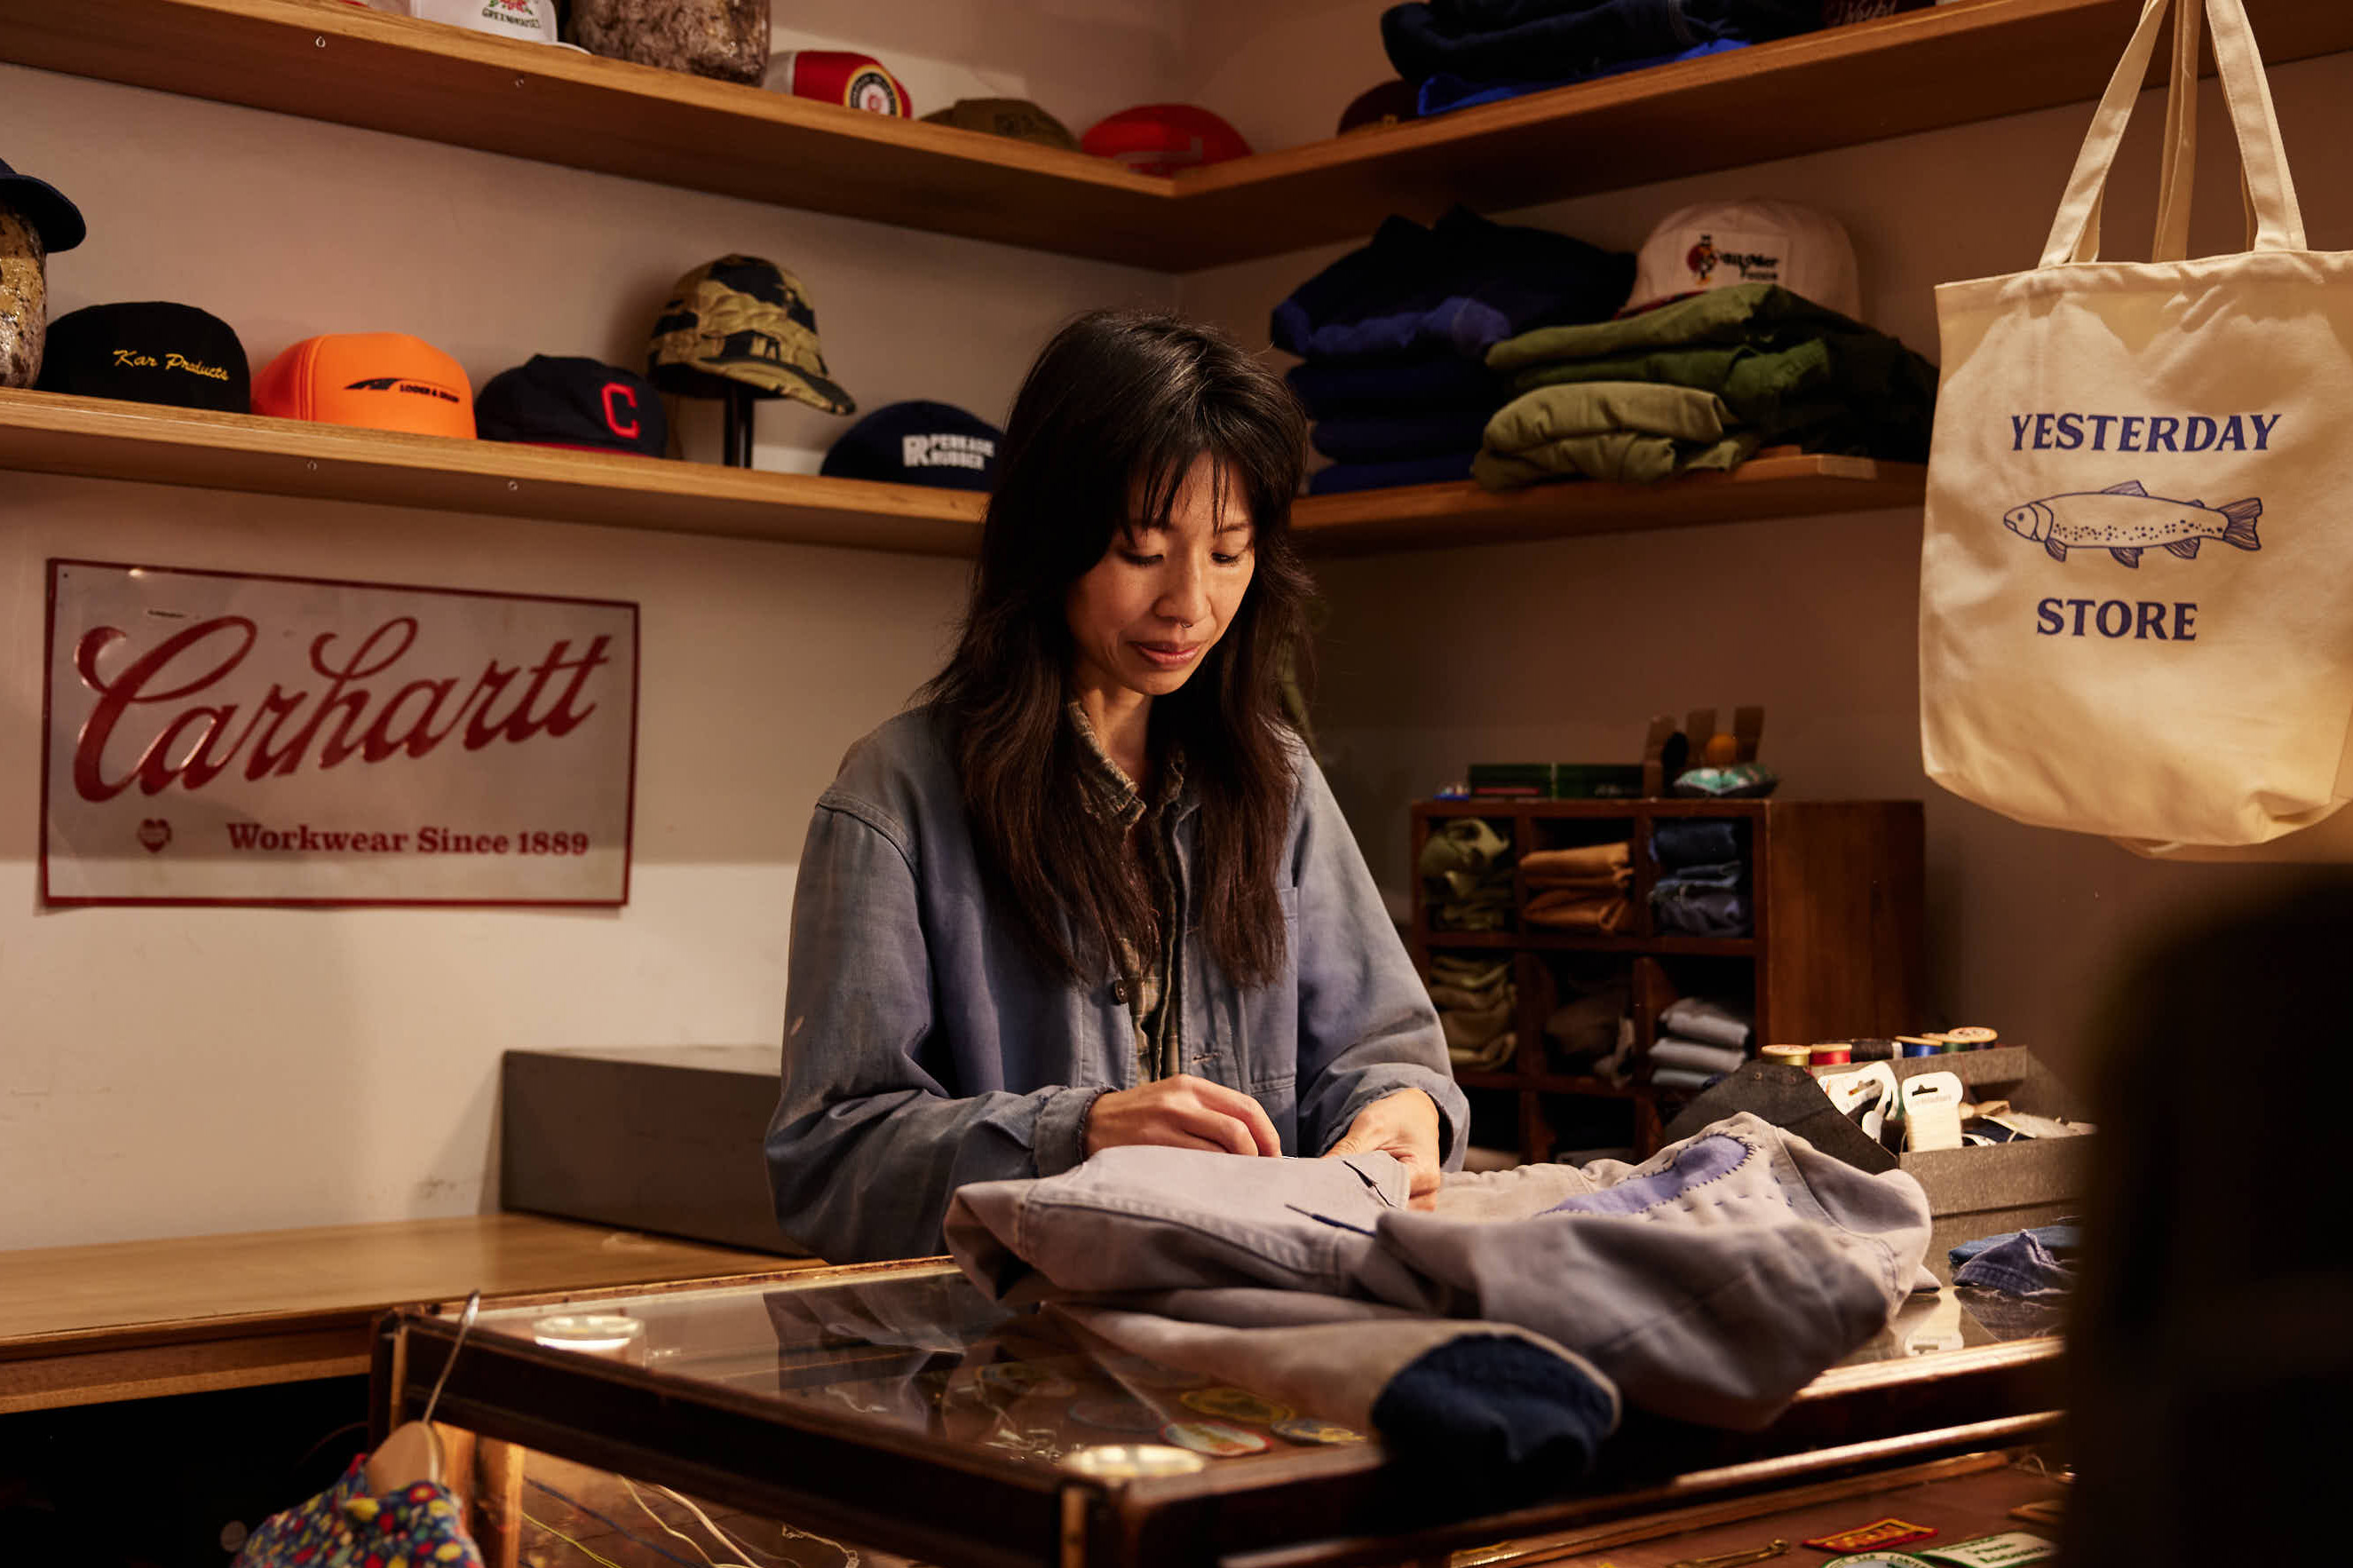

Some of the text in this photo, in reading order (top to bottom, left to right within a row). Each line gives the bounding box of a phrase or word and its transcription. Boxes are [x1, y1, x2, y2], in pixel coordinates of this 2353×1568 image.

[113, 350, 229, 382] Kar Products
[602, 382, 639, 440] C
[2011, 413, 2282, 453] YESTERDAY
[2037, 598, 2199, 641] STORE
[74, 615, 613, 803] Carhartt
[226, 821, 590, 857] Workwear Since 1889
